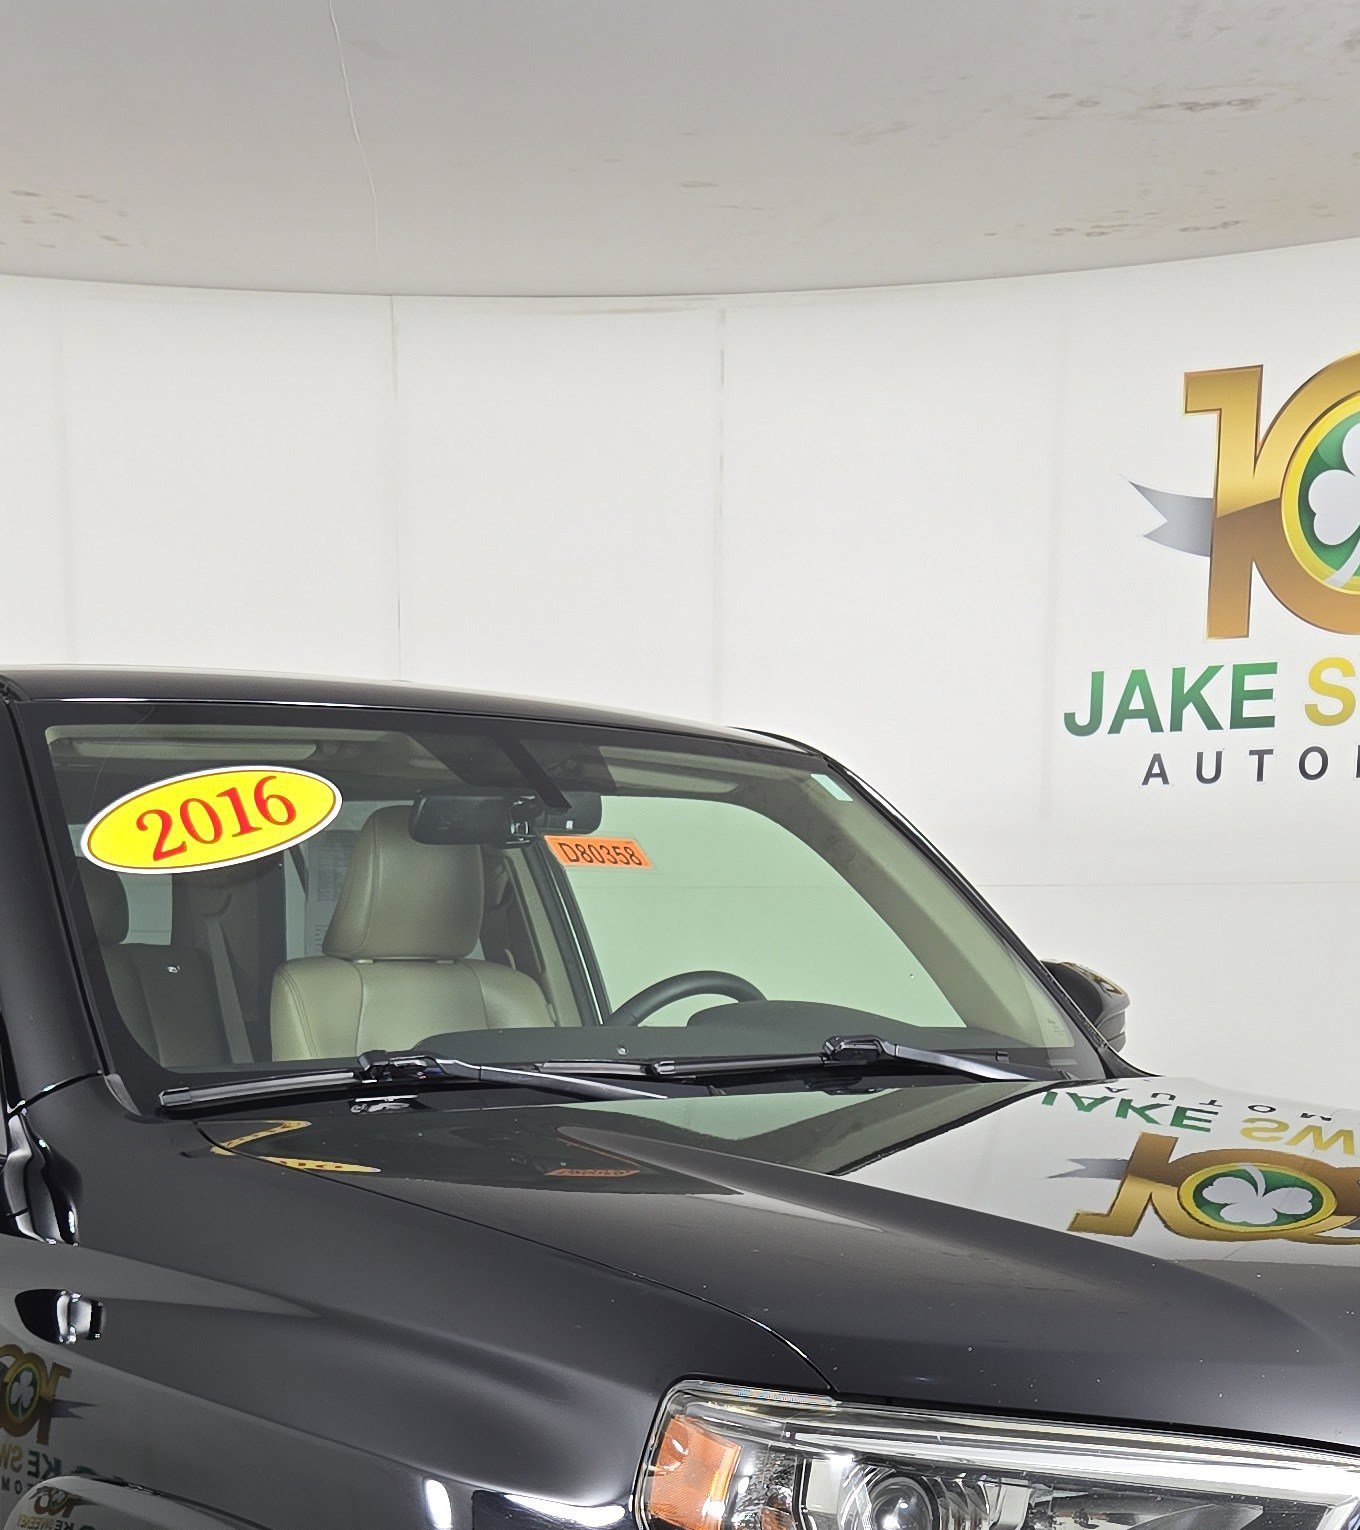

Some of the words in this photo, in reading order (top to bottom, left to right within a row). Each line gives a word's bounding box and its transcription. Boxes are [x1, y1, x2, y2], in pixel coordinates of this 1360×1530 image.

[1064, 661, 1278, 736] JAKE
[136, 775, 297, 861] 2016
[558, 842, 642, 866] D80358
